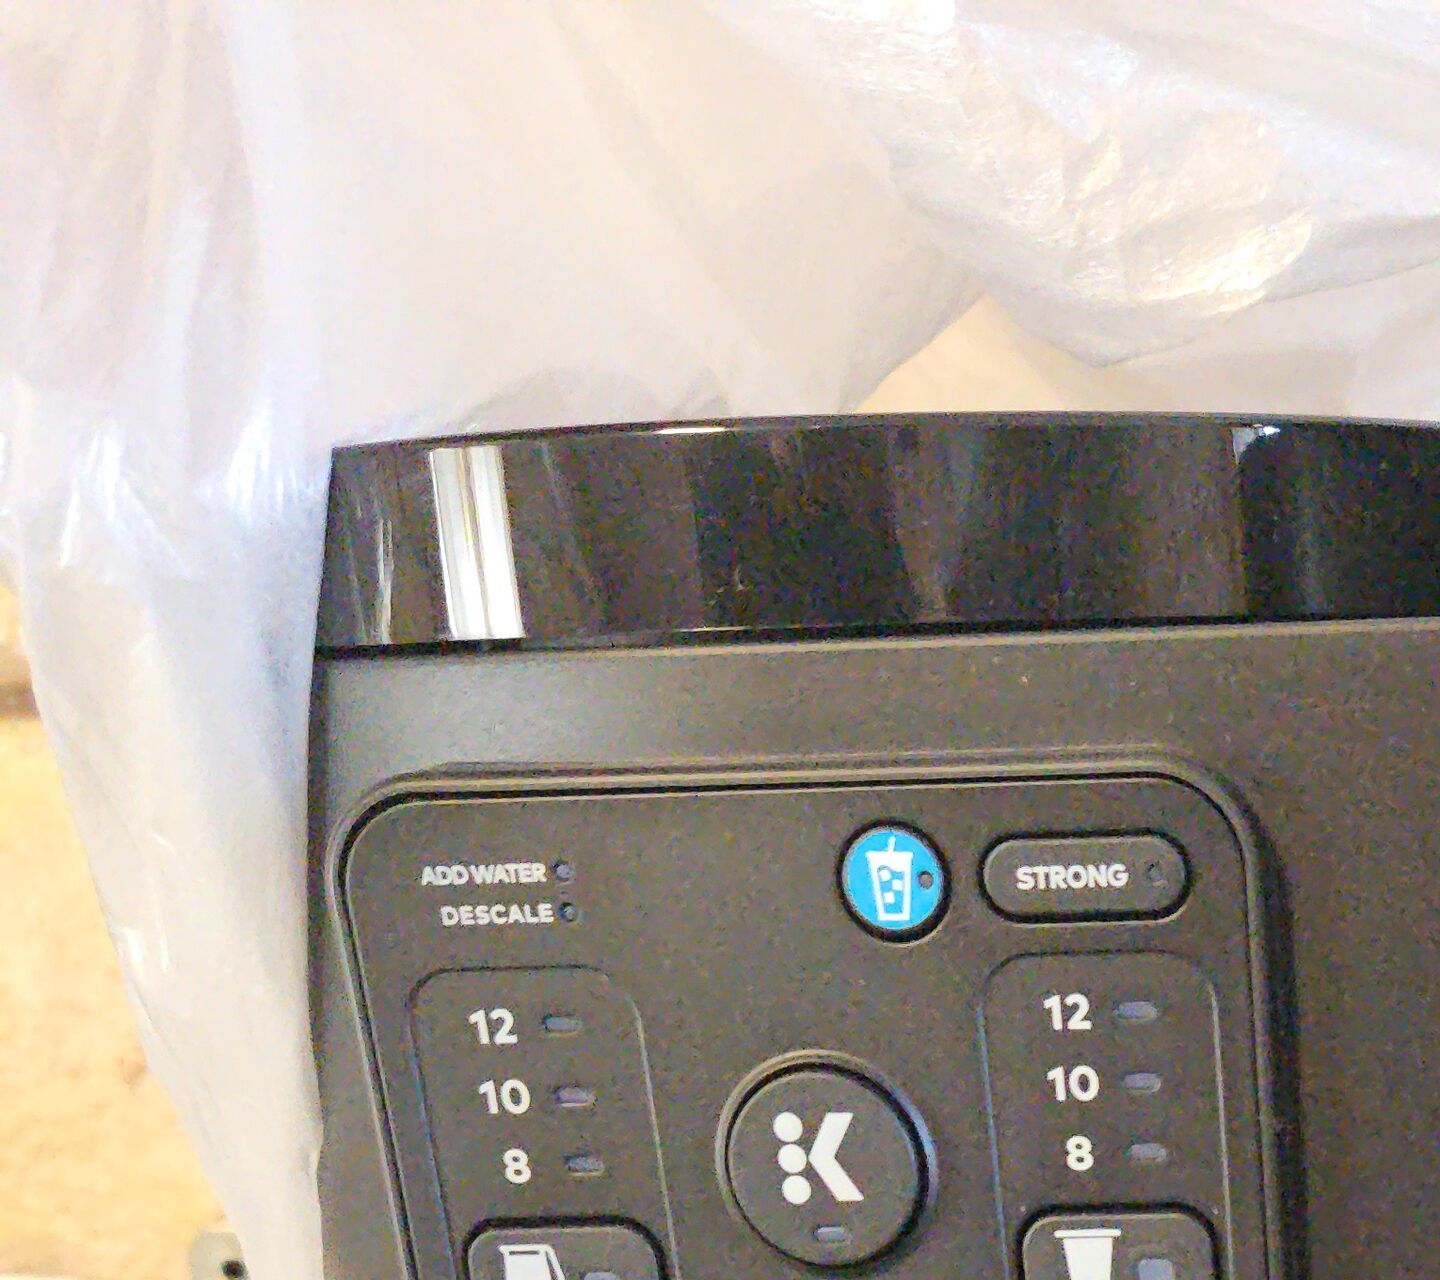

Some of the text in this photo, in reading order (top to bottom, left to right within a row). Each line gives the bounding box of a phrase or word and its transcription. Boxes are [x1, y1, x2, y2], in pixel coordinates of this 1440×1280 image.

[421, 862, 548, 886] ADD WATER
[1015, 863, 1130, 891] STRONG
[440, 902, 555, 927] DESCALE
[469, 1008, 519, 1046] 12
[1043, 993, 1093, 1031] 12
[479, 1079, 531, 1116] 10
[1047, 1065, 1100, 1103] 10
[503, 1149, 532, 1185] 8
[1066, 1136, 1095, 1172] 8
